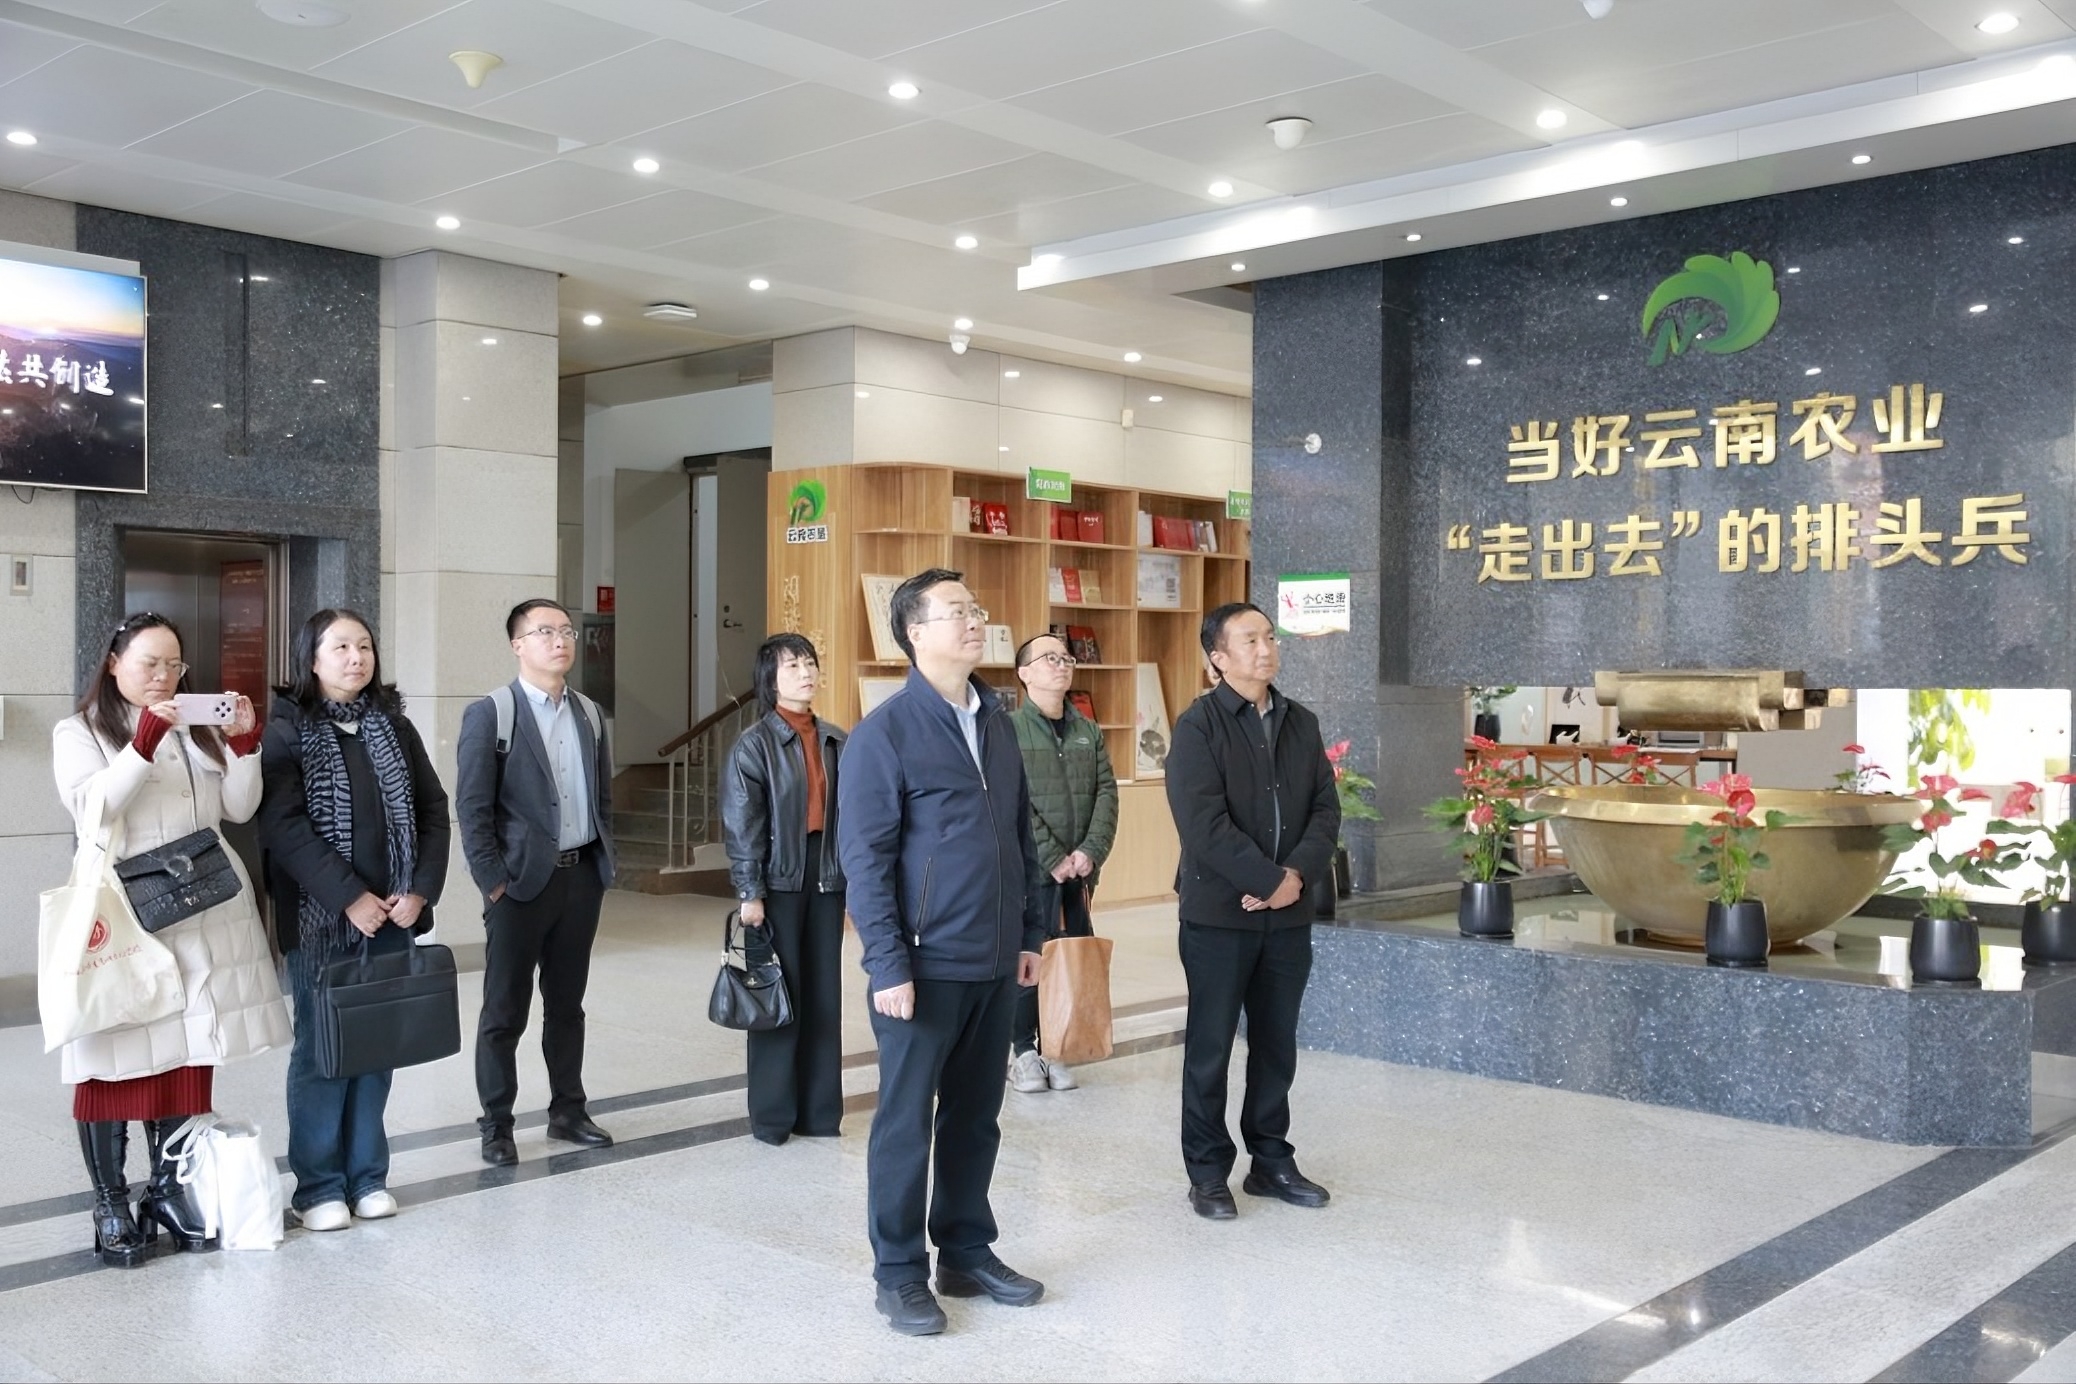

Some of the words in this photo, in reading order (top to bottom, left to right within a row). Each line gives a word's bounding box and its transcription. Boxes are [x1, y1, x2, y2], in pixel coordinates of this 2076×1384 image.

[1506, 382, 1943, 483] 当好云南农业
[1446, 493, 2031, 584] “走出去”的排头兵
